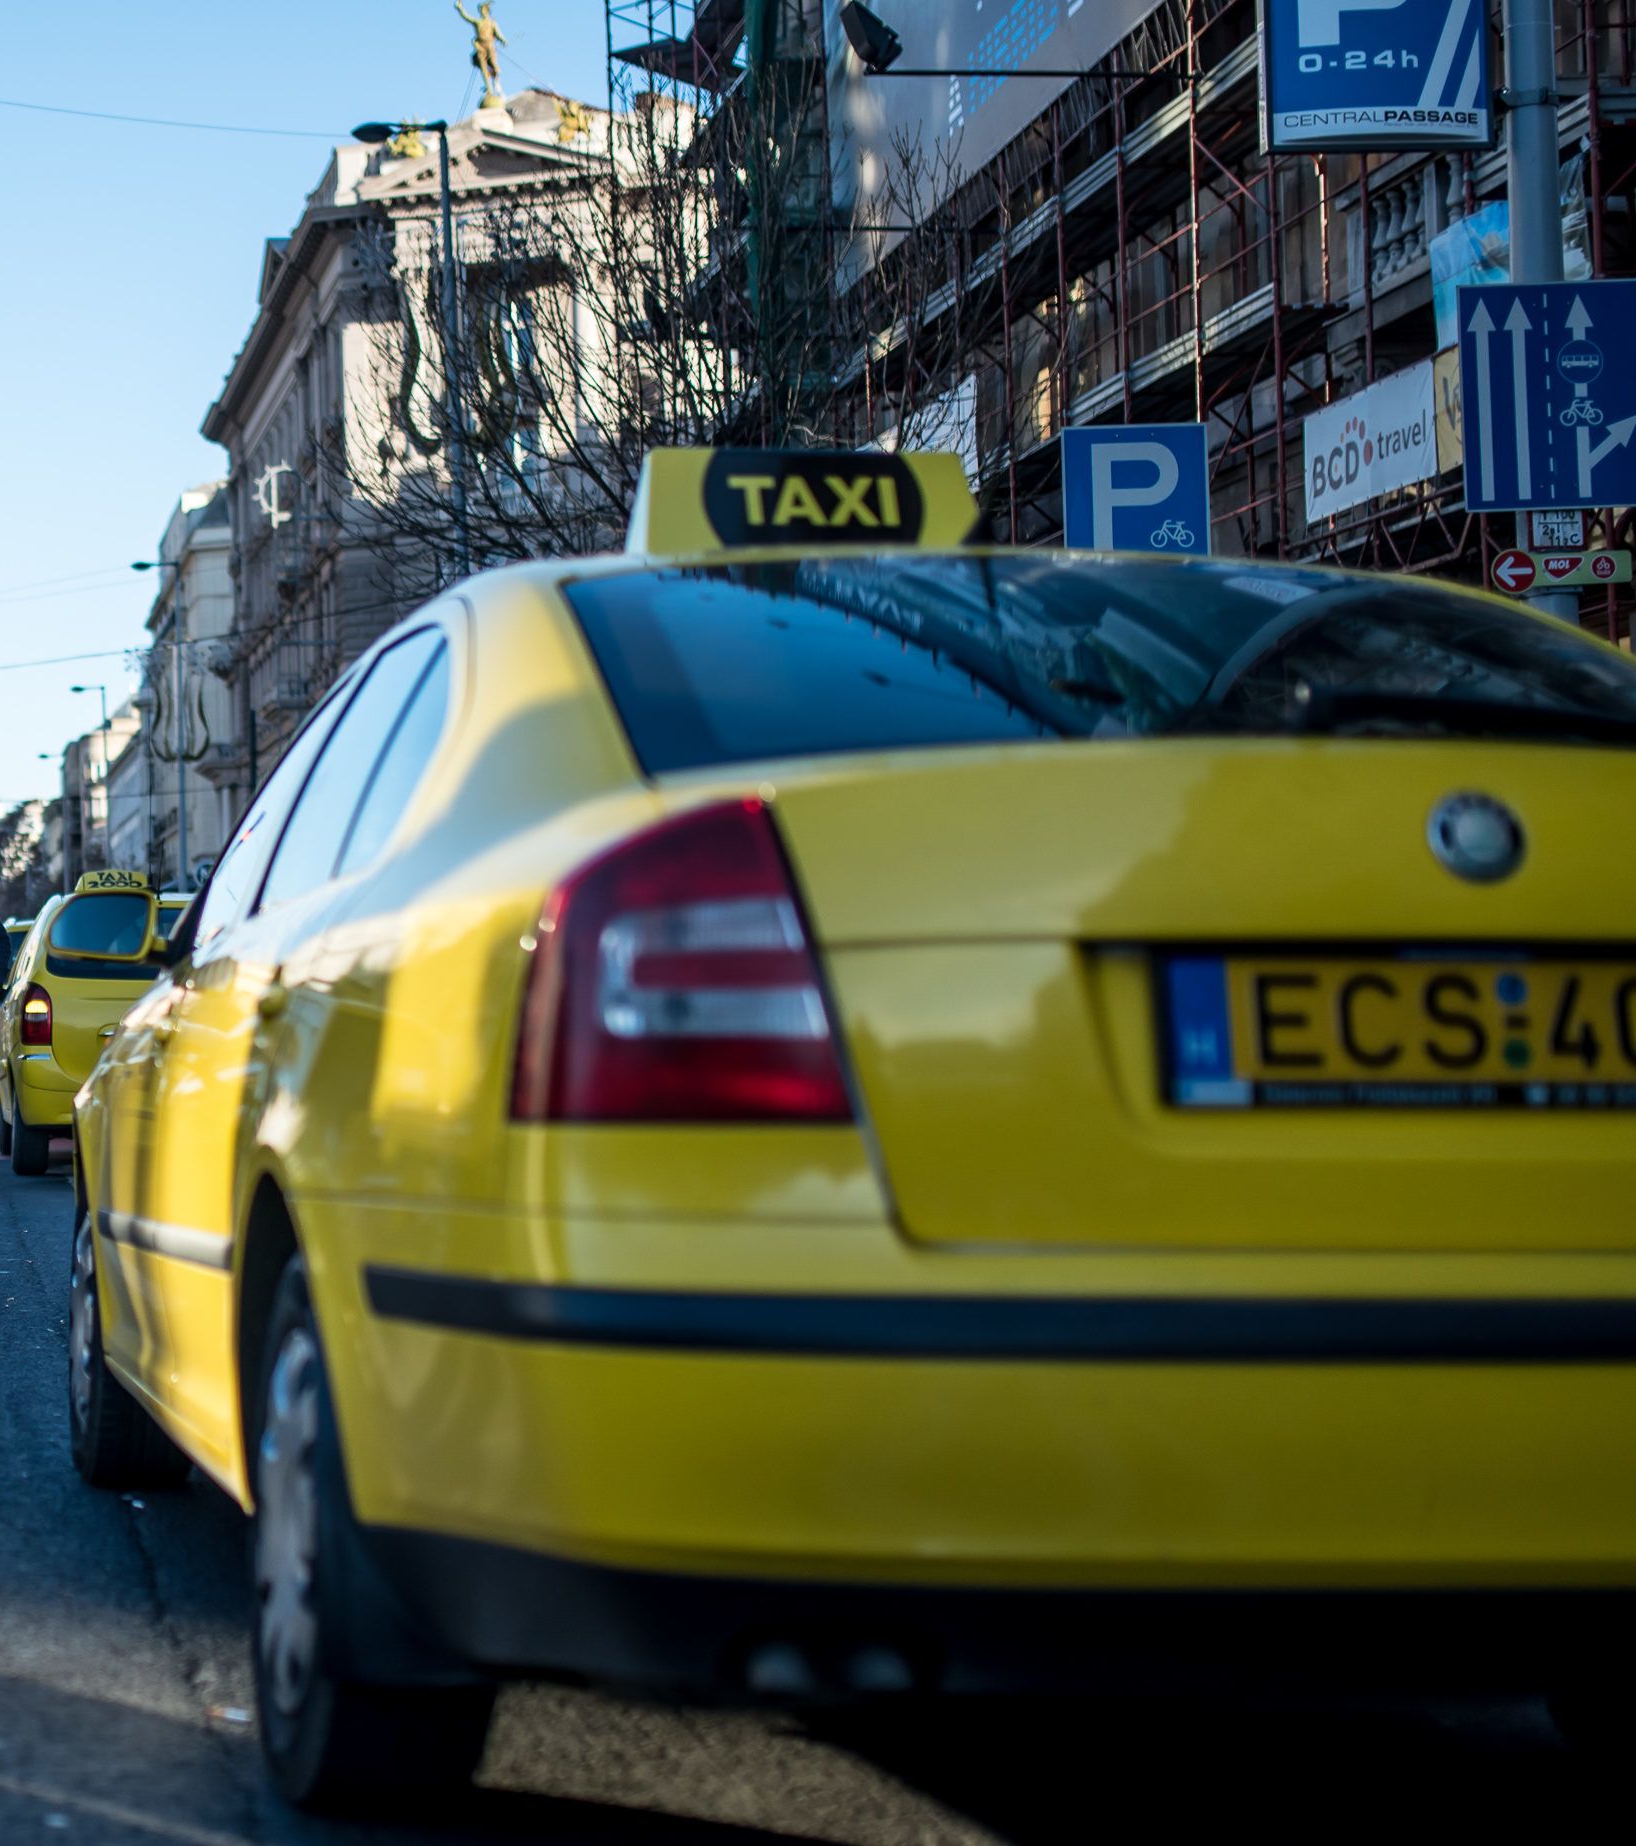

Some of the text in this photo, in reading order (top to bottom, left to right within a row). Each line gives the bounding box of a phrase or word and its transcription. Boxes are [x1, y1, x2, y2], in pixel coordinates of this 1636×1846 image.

[1313, 440, 1360, 499] BCD
[1377, 408, 1427, 460] travel
[727, 475, 901, 527] TAXI
[1091, 441, 1179, 551] P
[1548, 560, 1570, 570] MOL
[96, 871, 133, 881] TAXI
